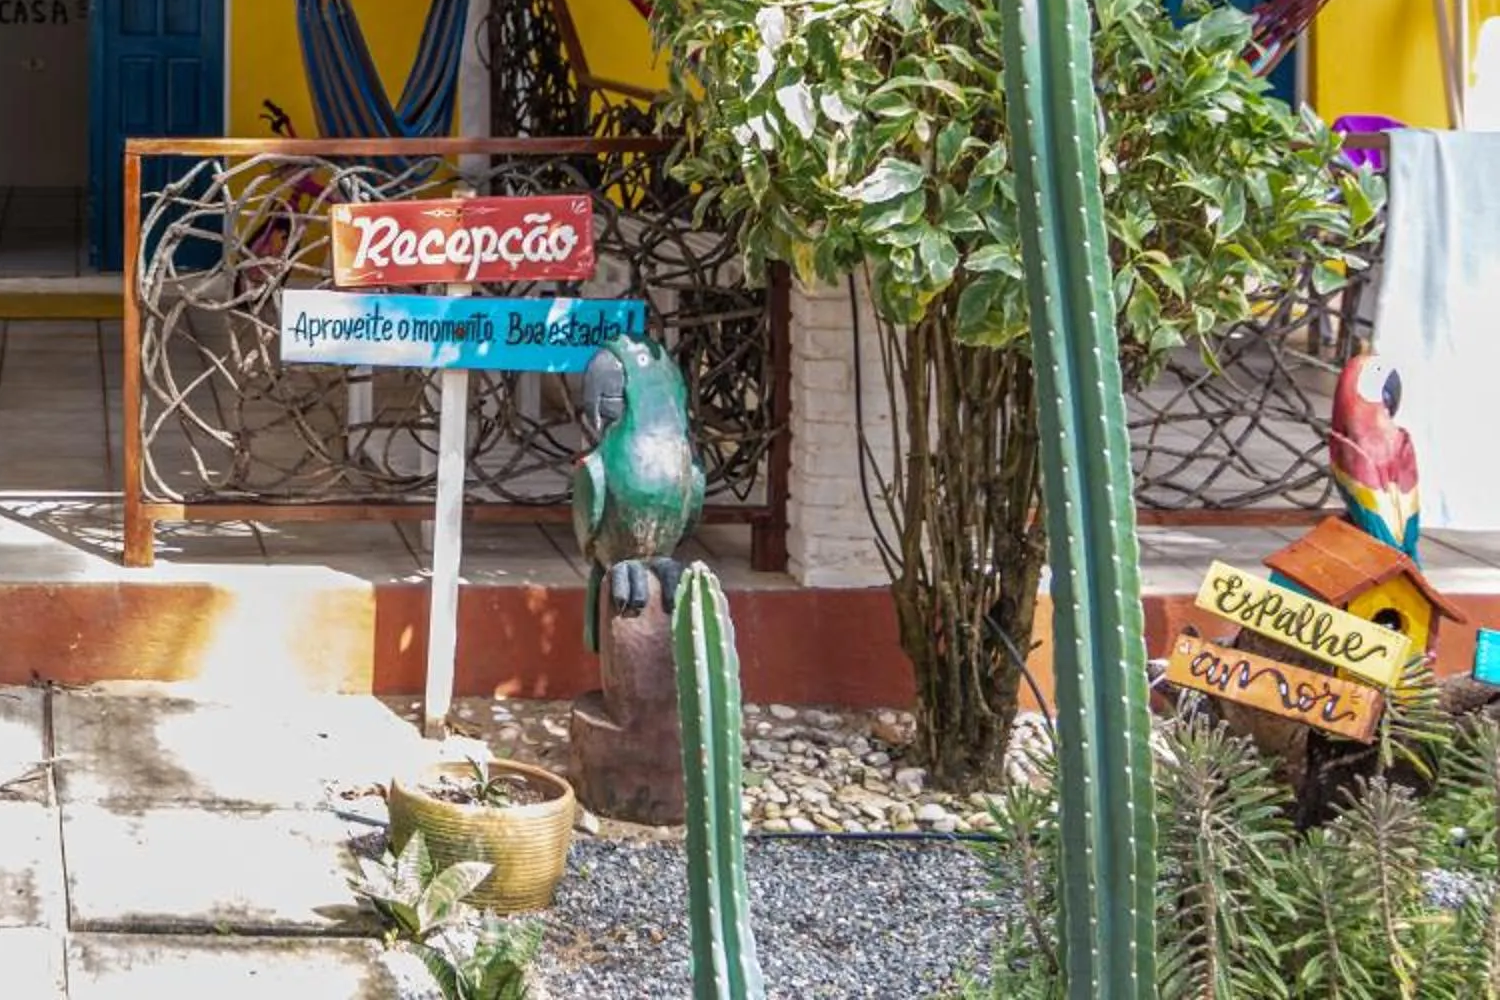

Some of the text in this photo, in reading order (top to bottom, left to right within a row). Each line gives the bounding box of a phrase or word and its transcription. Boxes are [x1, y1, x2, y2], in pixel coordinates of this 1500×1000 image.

[351, 212, 579, 281] Recepção
[289, 303, 394, 347] Aproveite
[397, 319, 410, 339] o
[505, 310, 546, 346] Boa
[1190, 651, 1355, 723] amor
